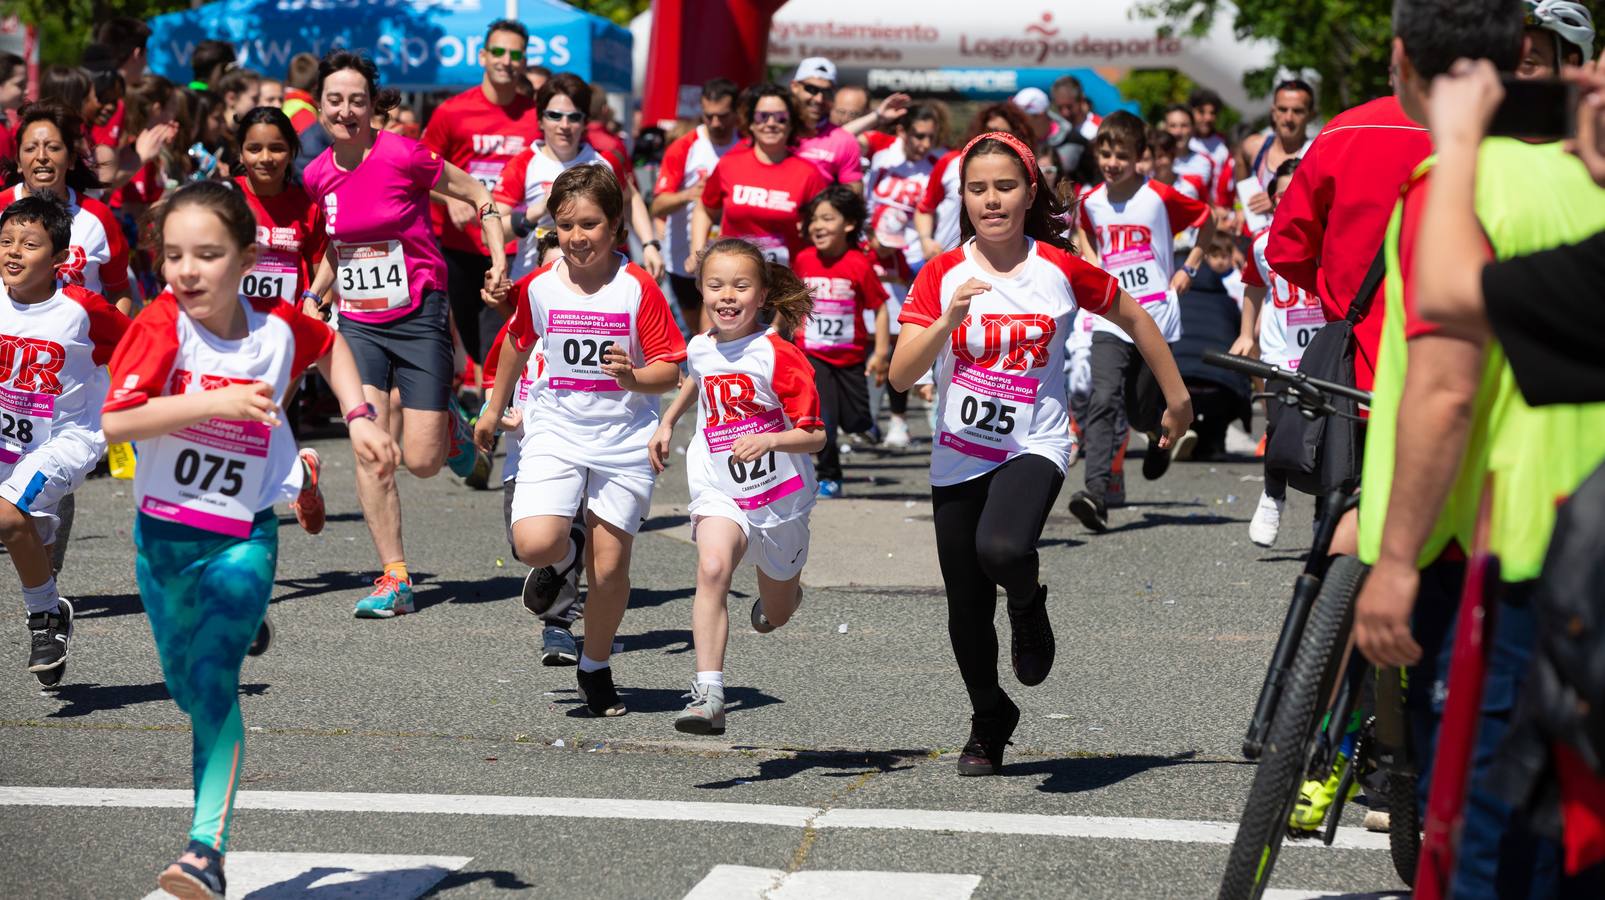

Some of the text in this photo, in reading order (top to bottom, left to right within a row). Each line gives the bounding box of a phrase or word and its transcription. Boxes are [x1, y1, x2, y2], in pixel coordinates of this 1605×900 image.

[733, 184, 768, 208] UR
[243, 274, 284, 298] 061
[342, 264, 402, 291] 3114
[1119, 267, 1149, 289] 118
[817, 319, 844, 336] 122
[563, 339, 615, 366] 026
[952, 314, 1057, 370] UR
[958, 371, 996, 388] UNIVERSIDAD
[996, 381, 1006, 389] DE
[1015, 387, 1033, 395] RIOJA
[959, 365, 1012, 384] CARRERA CAMPUS
[732, 421, 758, 432] CAMPUS
[960, 396, 1017, 435] 025
[174, 448, 246, 497] 075
